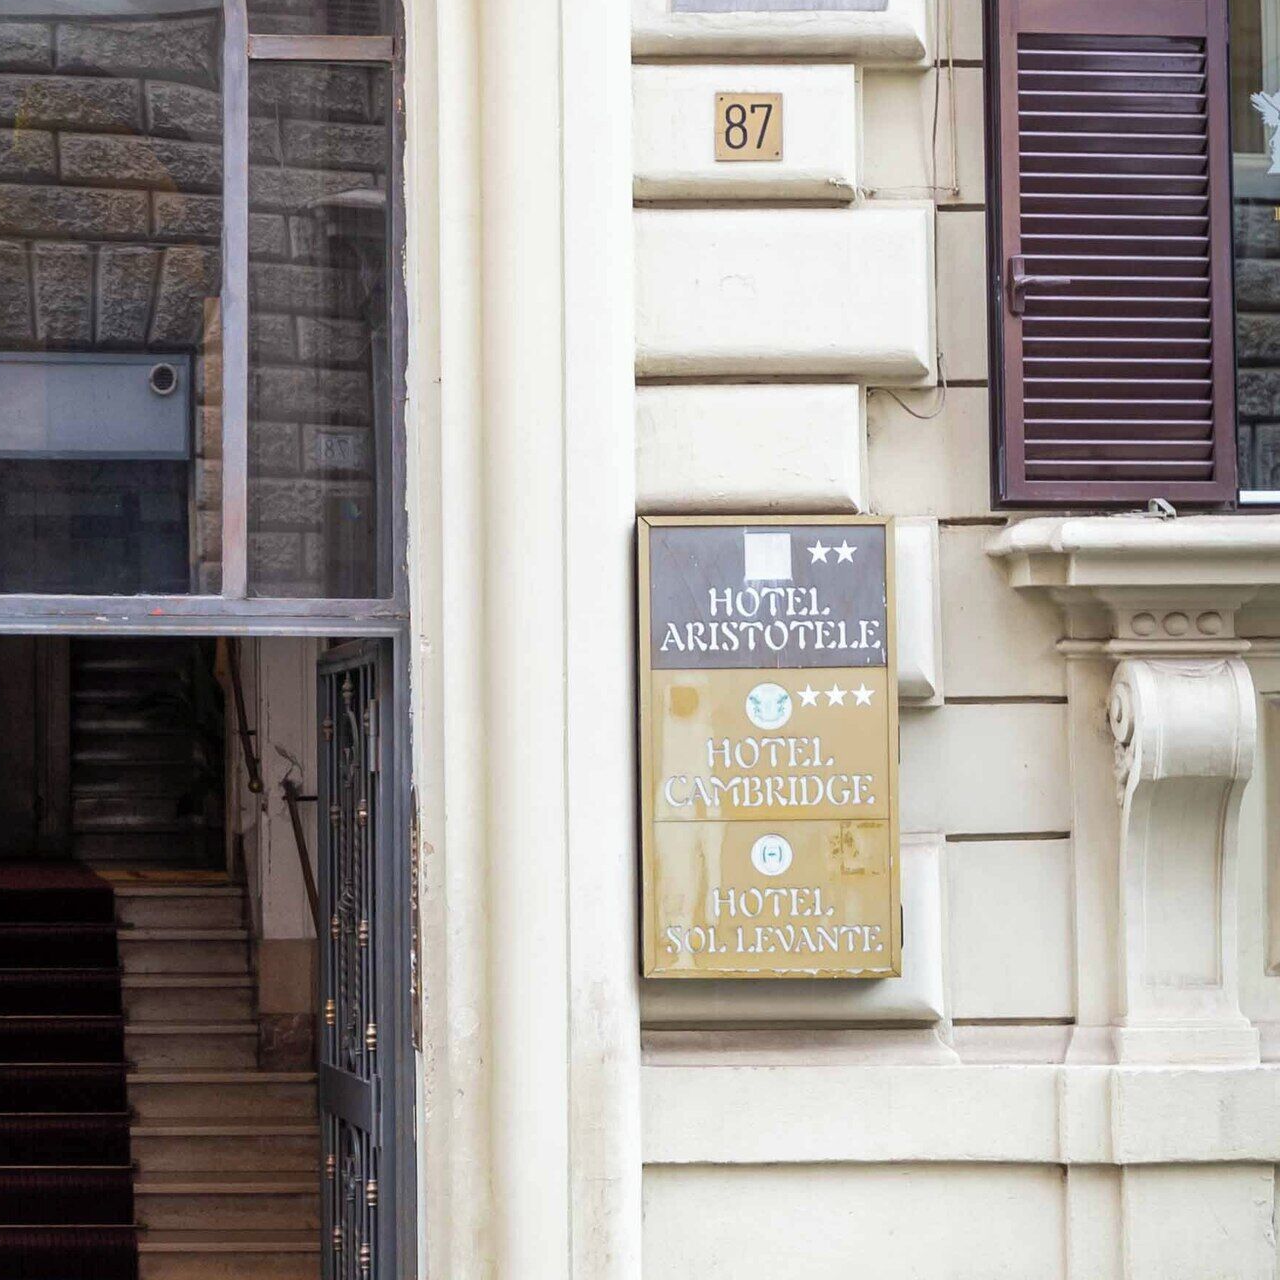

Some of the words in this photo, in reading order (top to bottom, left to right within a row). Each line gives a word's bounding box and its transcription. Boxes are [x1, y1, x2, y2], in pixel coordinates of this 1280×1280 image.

[724, 103, 773, 150] 87
[709, 586, 830, 617] HOTEL
[660, 620, 881, 652] ARISTOTELE
[706, 736, 835, 768] HOTEL
[664, 773, 875, 808] CAMBRIDGE
[713, 887, 835, 918] HOTEL
[666, 924, 726, 954] SOL
[736, 923, 883, 954] LEVANTE
